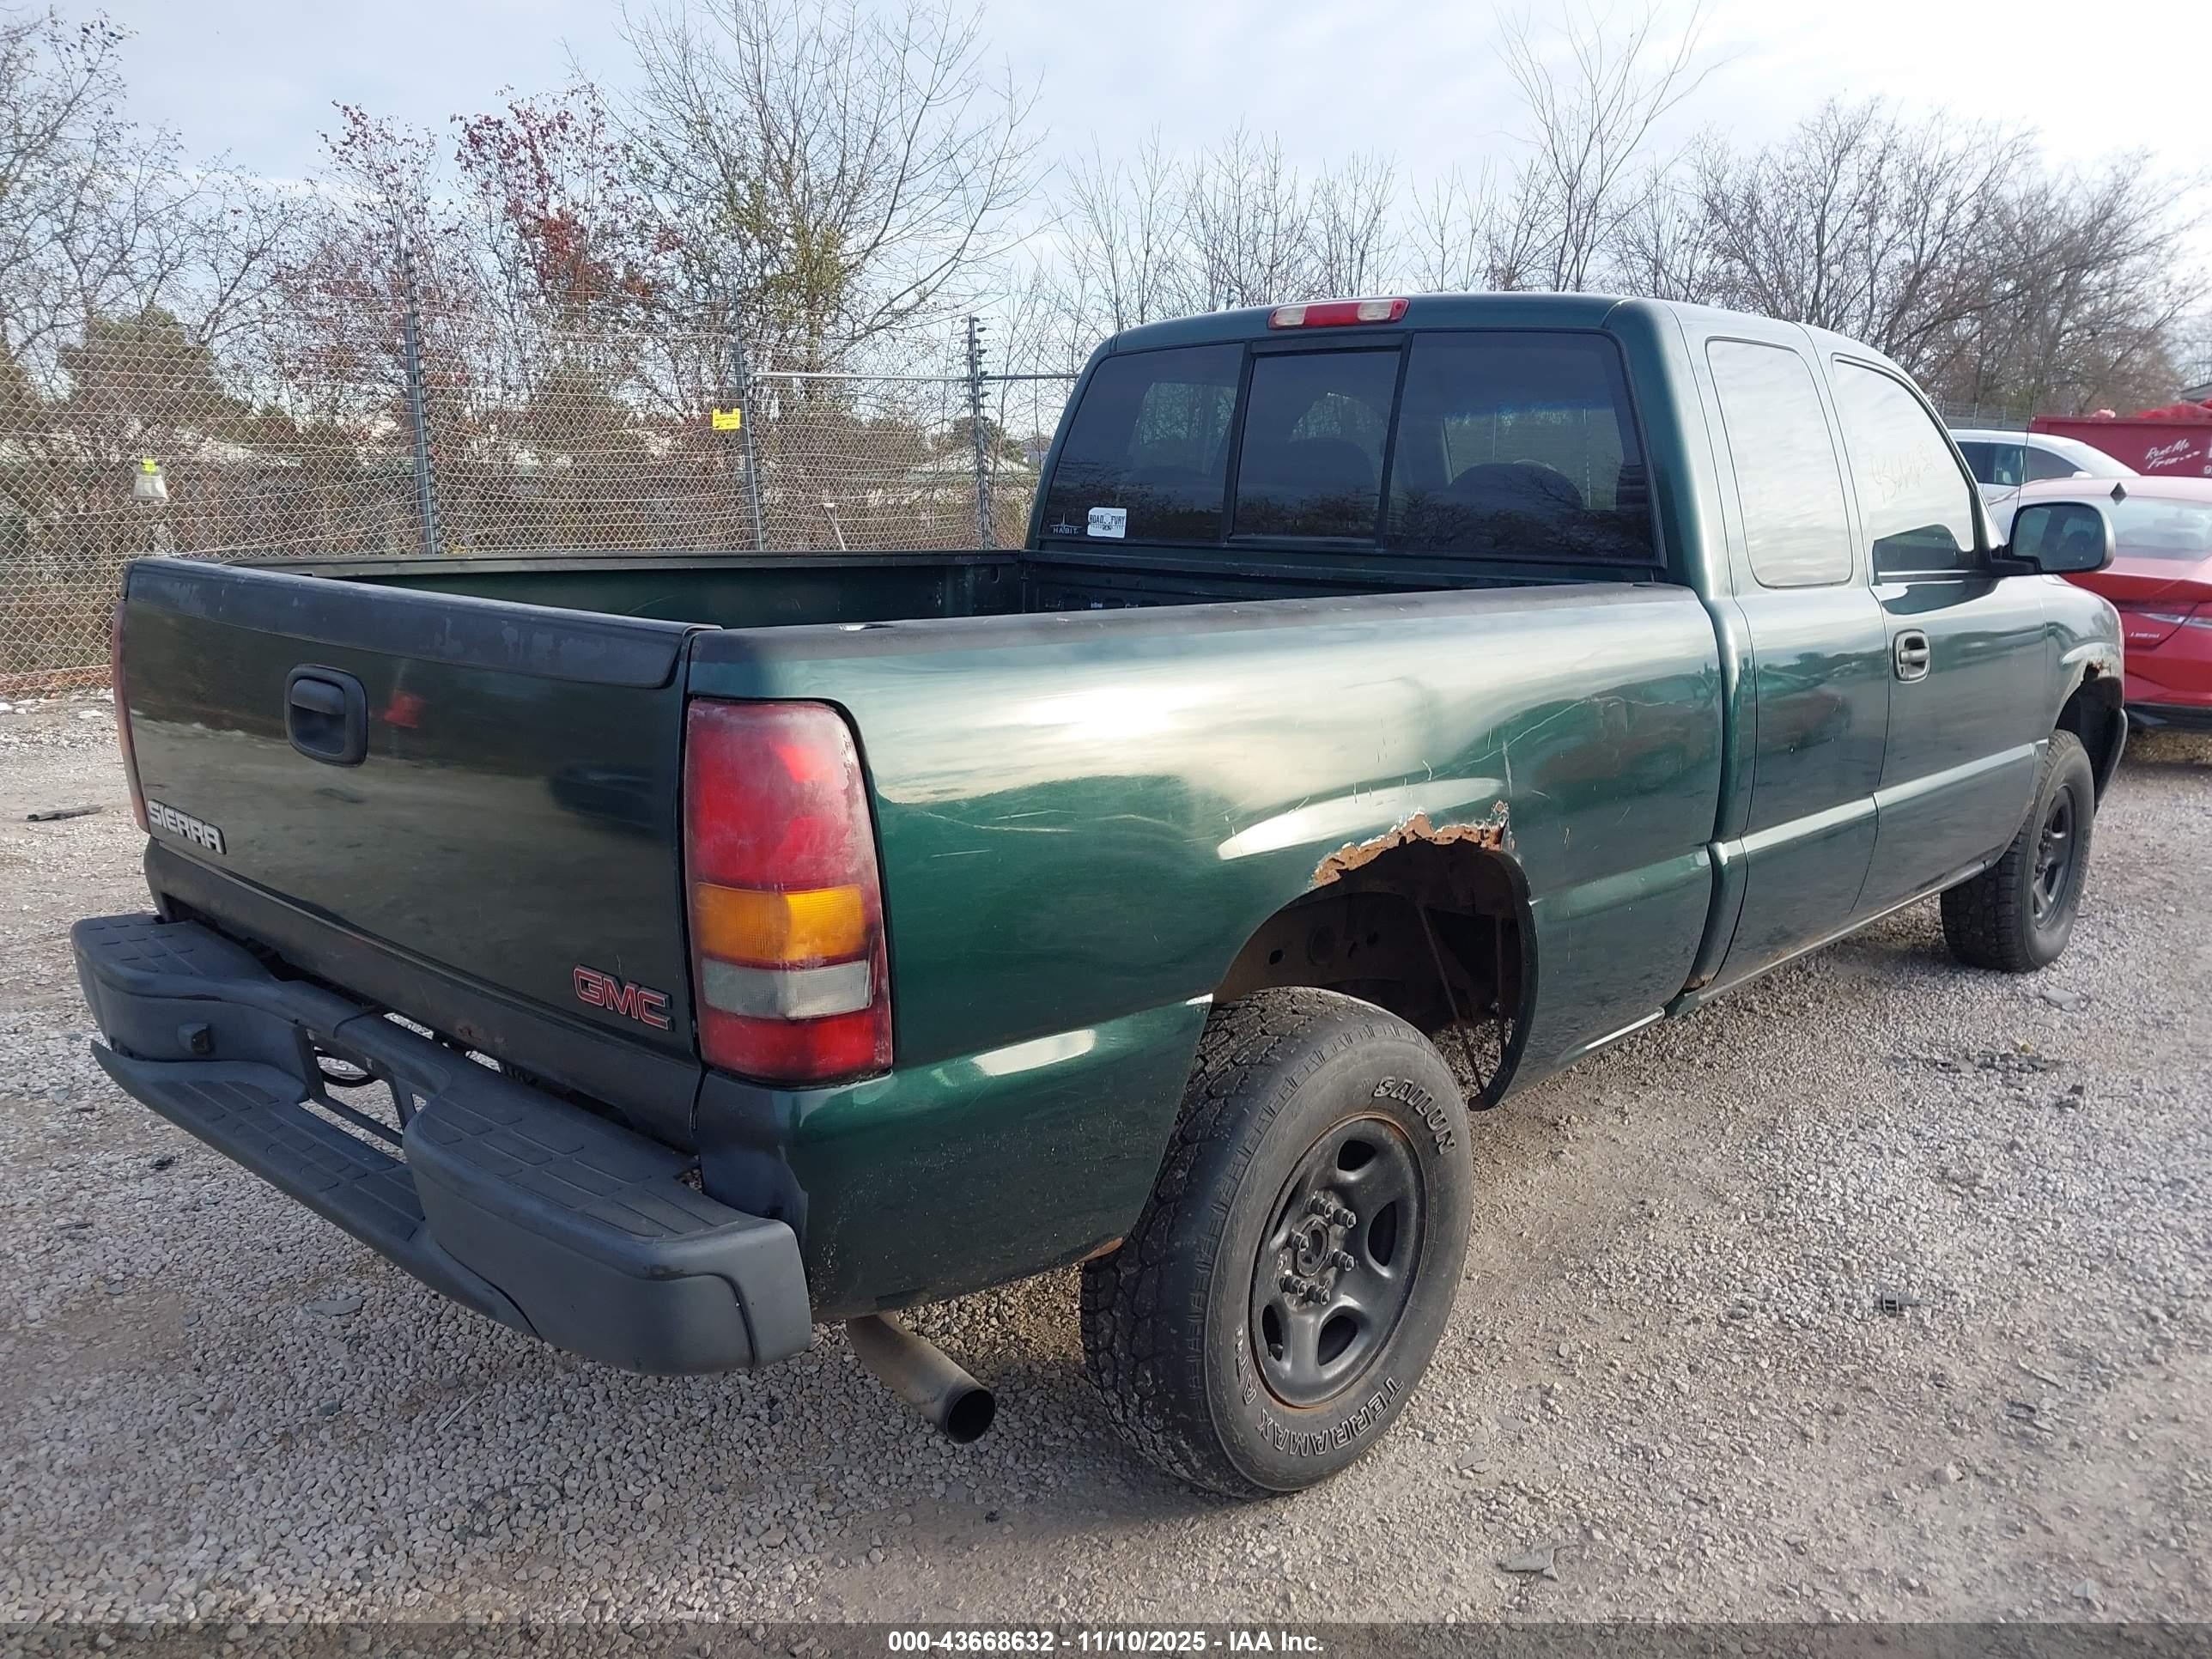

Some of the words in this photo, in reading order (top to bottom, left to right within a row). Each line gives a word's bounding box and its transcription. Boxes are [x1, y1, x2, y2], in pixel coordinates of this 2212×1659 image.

[1089, 514, 1104, 524] ROAD
[1110, 515, 1126, 525] FURY
[148, 799, 225, 854] SIERRA
[574, 965, 671, 1031] GMC
[1373, 1076, 1456, 1155] SAILUN
[1257, 1376, 1403, 1457] TERRAMAX
